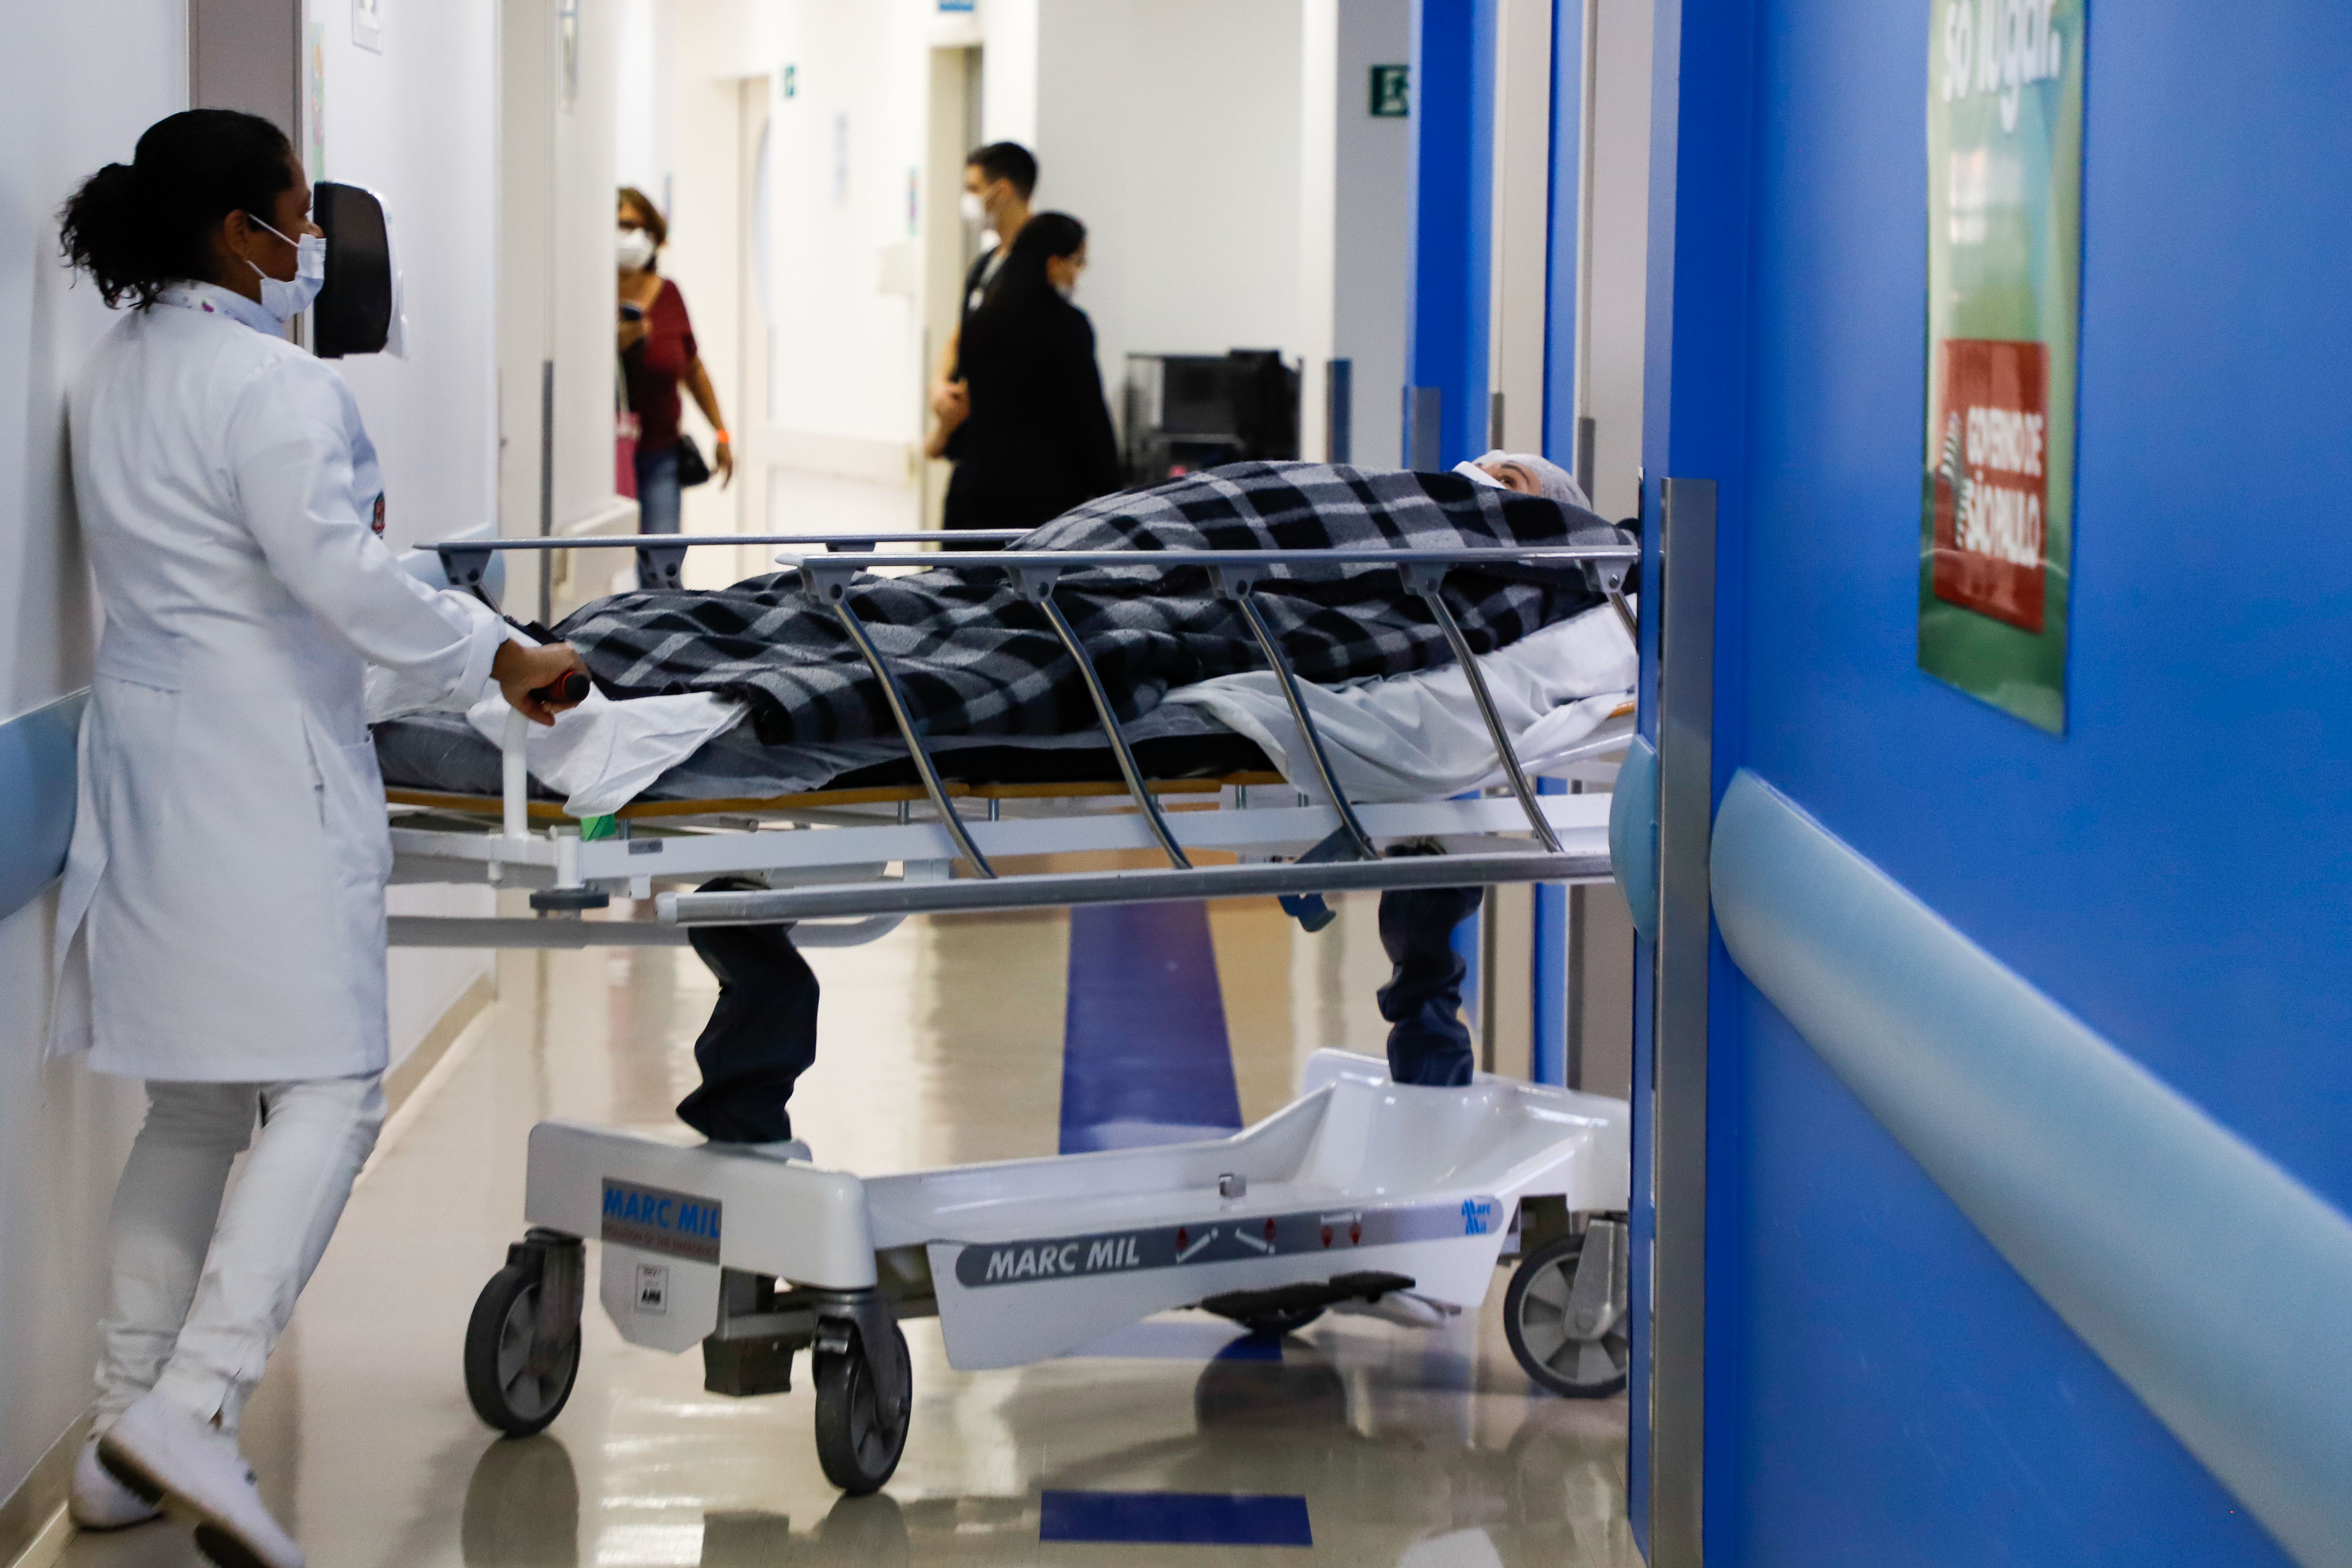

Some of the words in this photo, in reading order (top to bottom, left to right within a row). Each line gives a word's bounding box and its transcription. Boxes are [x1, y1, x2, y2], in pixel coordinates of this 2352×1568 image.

[2024, 413, 2043, 477] DE
[1993, 485, 2041, 568] PAULO
[603, 1187, 672, 1229] MARC
[678, 1202, 721, 1239] MIL
[985, 1243, 1079, 1283] MARC
[1085, 1236, 1140, 1272] MIL
